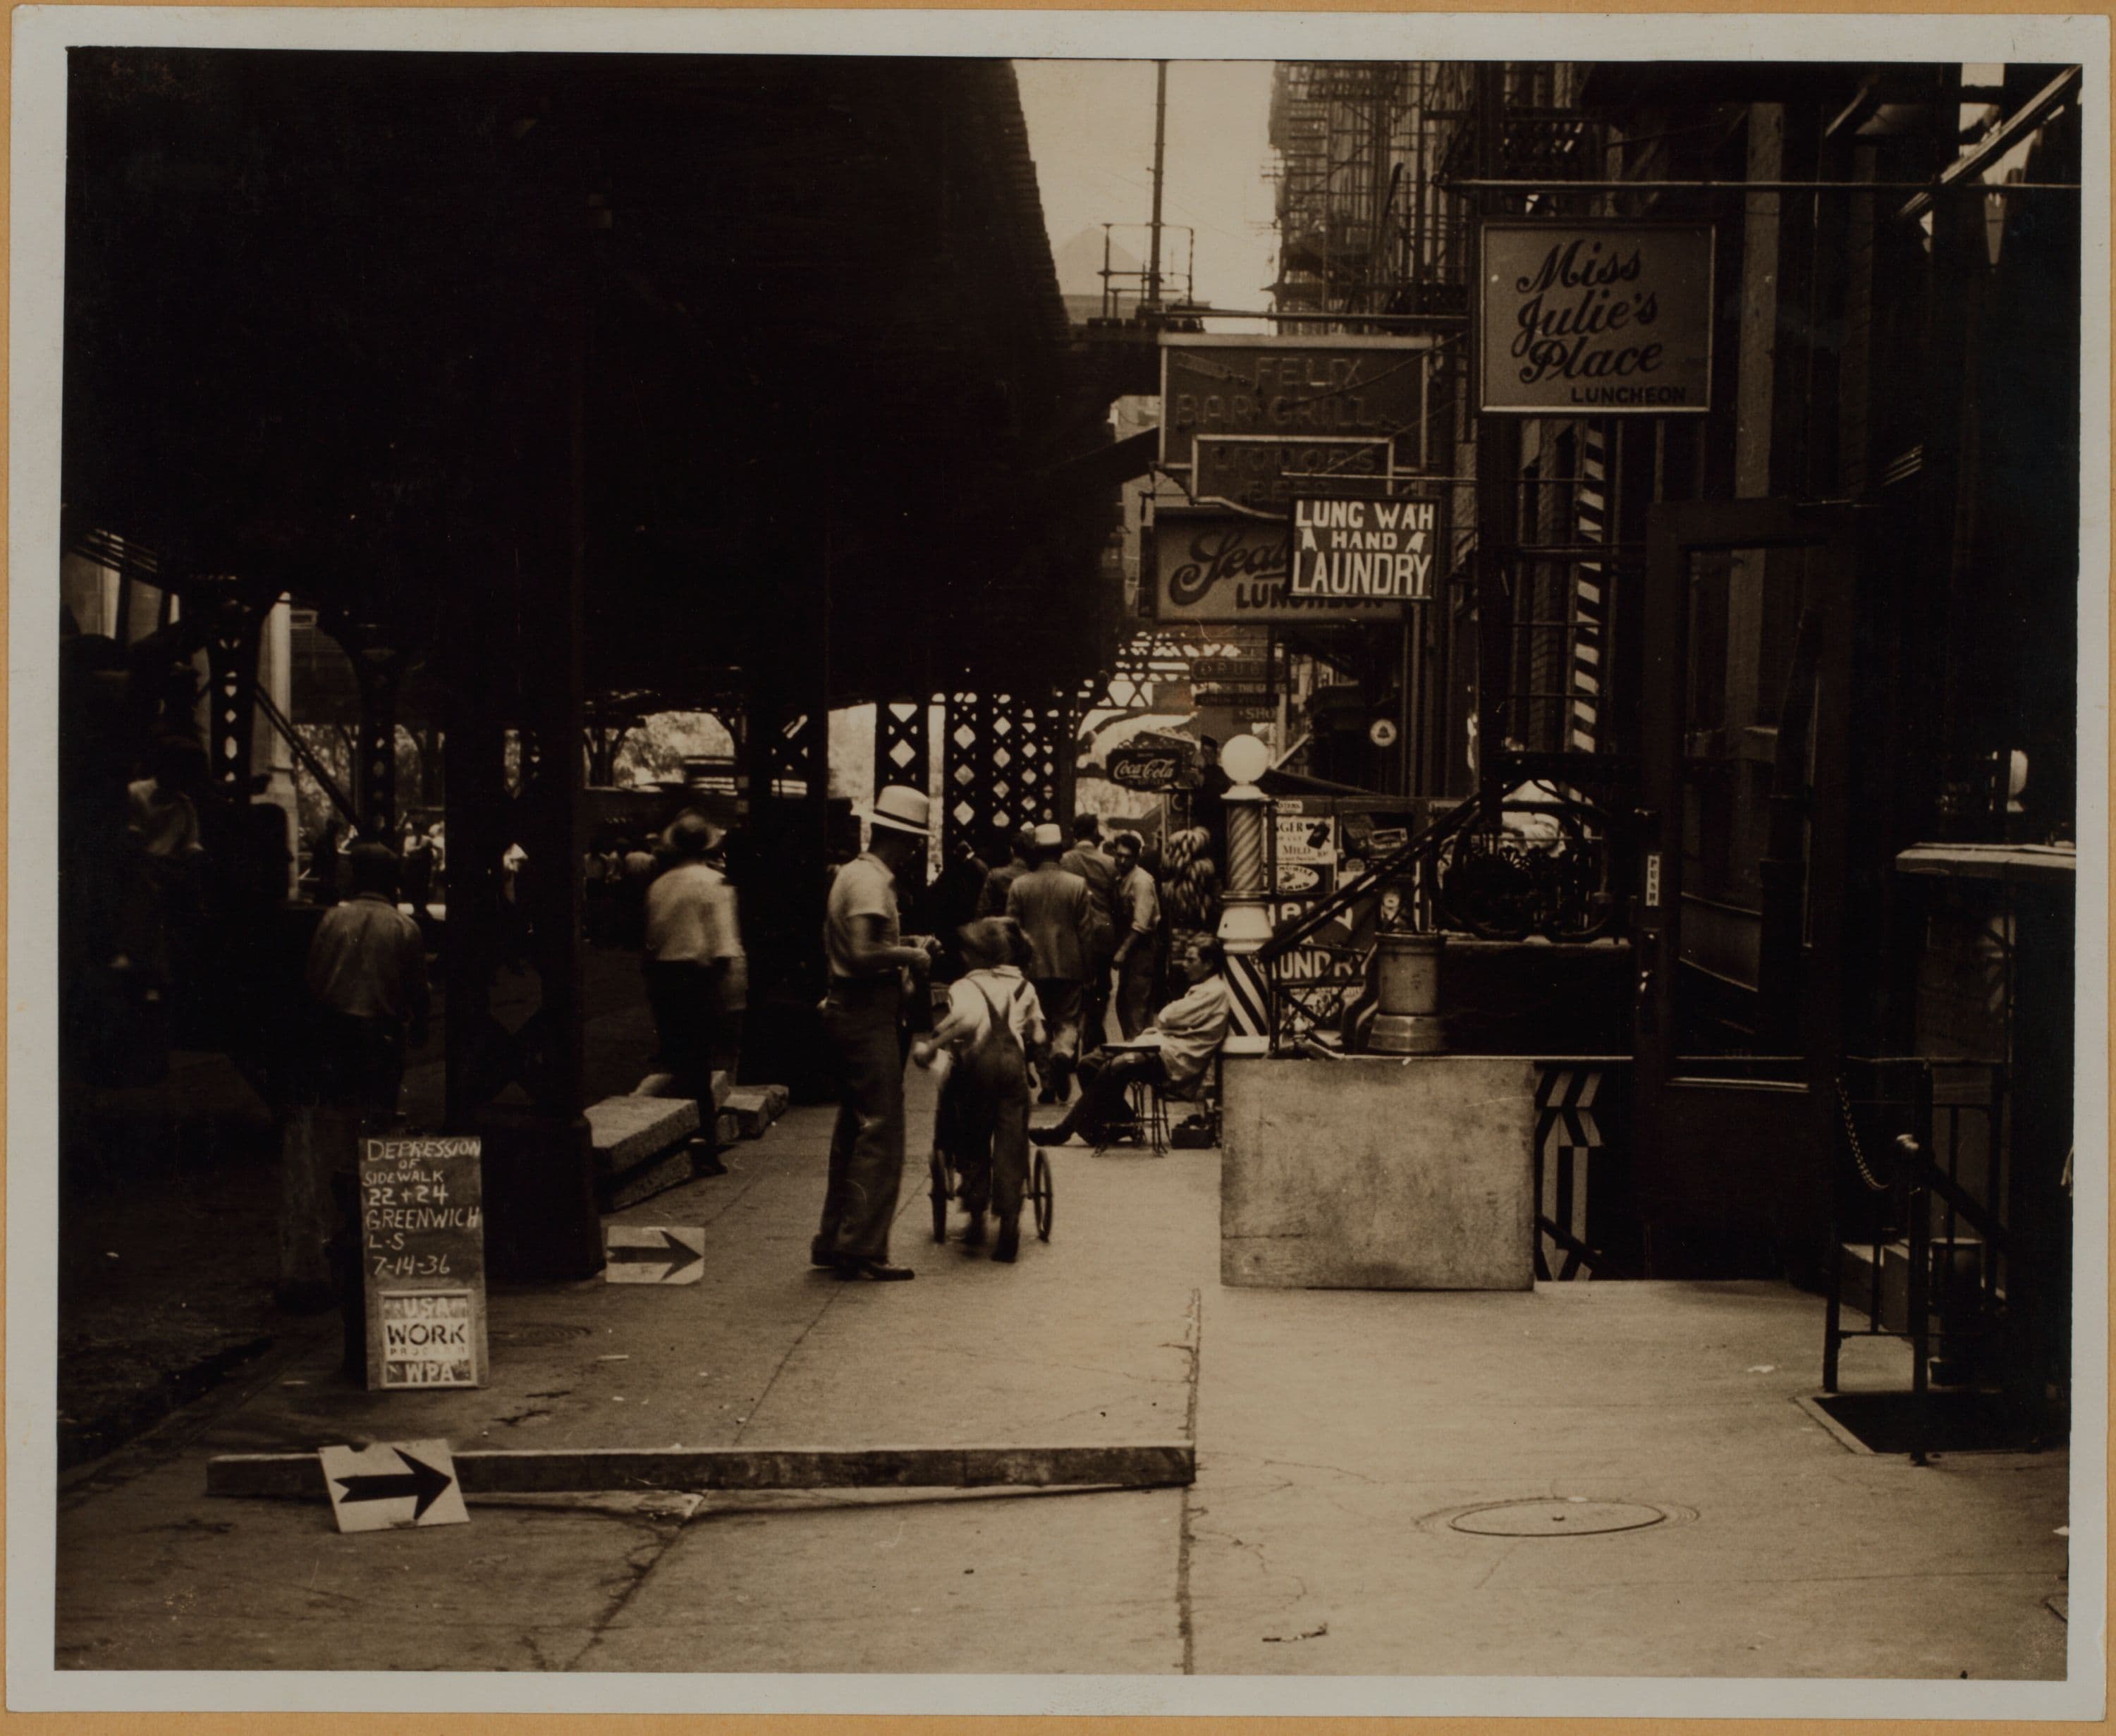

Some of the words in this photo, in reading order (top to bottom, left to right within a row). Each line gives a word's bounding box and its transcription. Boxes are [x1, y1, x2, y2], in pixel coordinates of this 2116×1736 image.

[1517, 238, 1641, 293] Miss
[1511, 288, 1658, 357] Julie's
[1519, 336, 1663, 384] Place
[1571, 386, 1686, 403] LUNCHEON
[1295, 500, 1364, 529] LUNG
[1374, 502, 1435, 530] WAH
[1331, 532, 1398, 550] HAND
[1292, 551, 1433, 596] LAUNDRY
[1649, 859, 1658, 901] PUSH
[367, 1138, 481, 1162] DEPRESSION
[398, 1159, 421, 1170] OF
[362, 1170, 444, 1187] SIDEWALK
[367, 1187, 397, 1206] 22
[415, 1184, 448, 1205] 24
[365, 1206, 481, 1230] GREENWICH
[372, 1254, 451, 1276] 7-14-36
[386, 1323, 465, 1345] WORK
[405, 1362, 455, 1383] WPA
